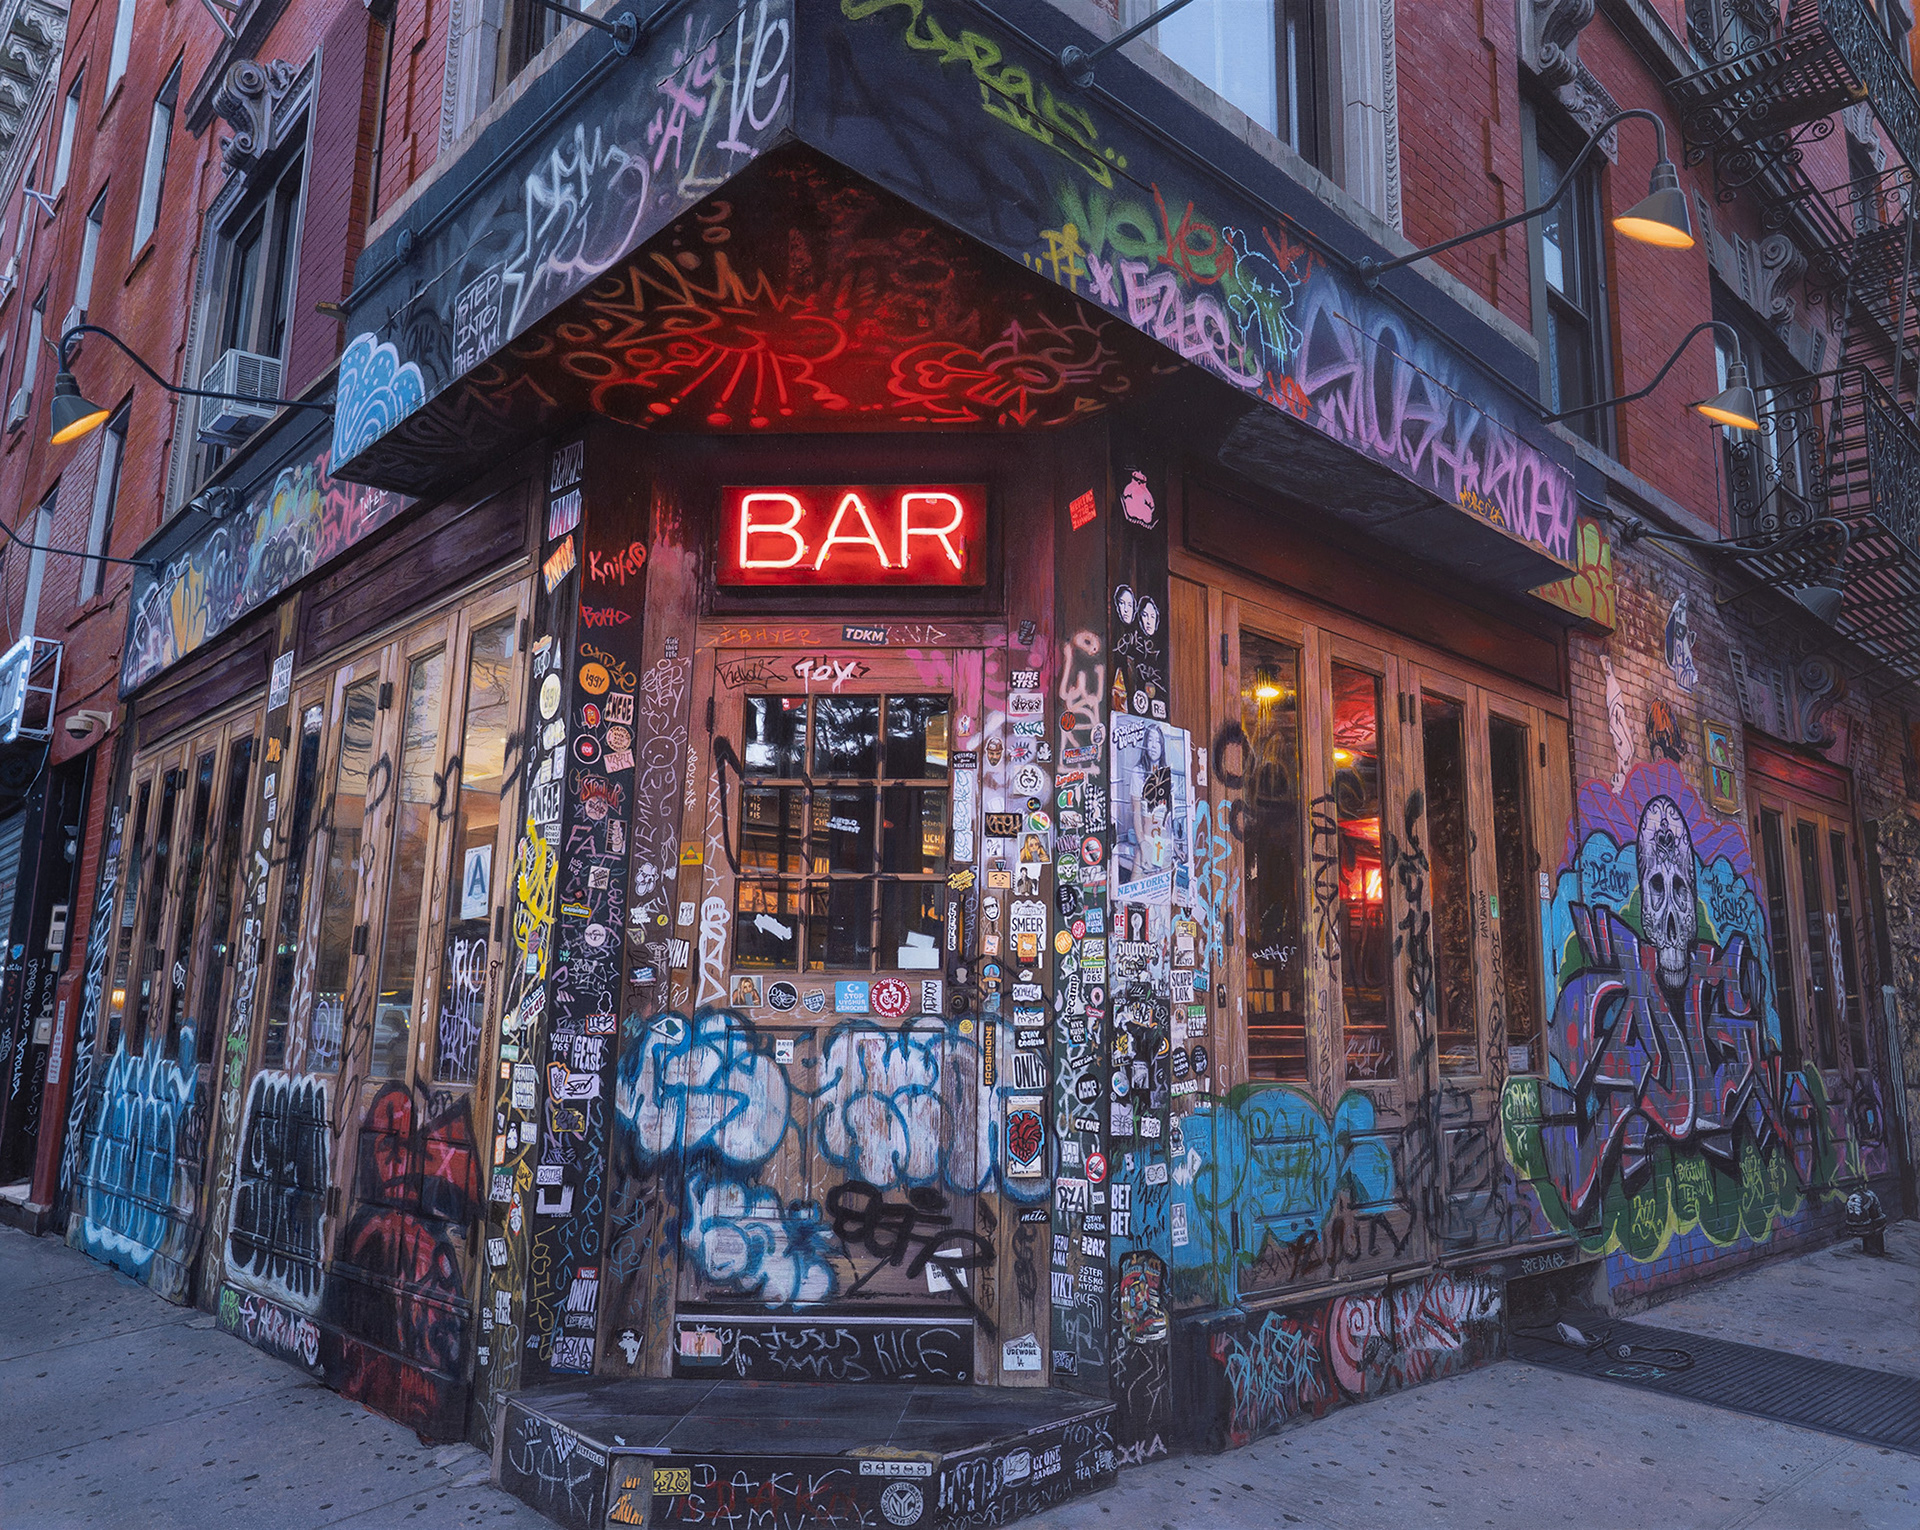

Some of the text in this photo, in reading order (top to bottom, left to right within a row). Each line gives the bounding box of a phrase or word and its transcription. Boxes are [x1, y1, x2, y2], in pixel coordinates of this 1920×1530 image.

[457, 304, 499, 350] INTO
[739, 492, 964, 572] BAR
[845, 627, 885, 643] TDKM
[585, 669, 605, 691] iggy
[795, 660, 857, 694] TOY
[1012, 671, 1039, 681] TORE
[467, 855, 487, 897] A
[1117, 882, 1139, 898] NEW
[1011, 917, 1043, 932] SMEER
[550, 1033, 574, 1043] VAULT
[1020, 1030, 1040, 1040] STAY
[1111, 1183, 1132, 1210] BET
[1085, 1215, 1103, 1223] STAY
[1110, 1211, 1131, 1236] BET
[889, 1491, 915, 1517] NYC
